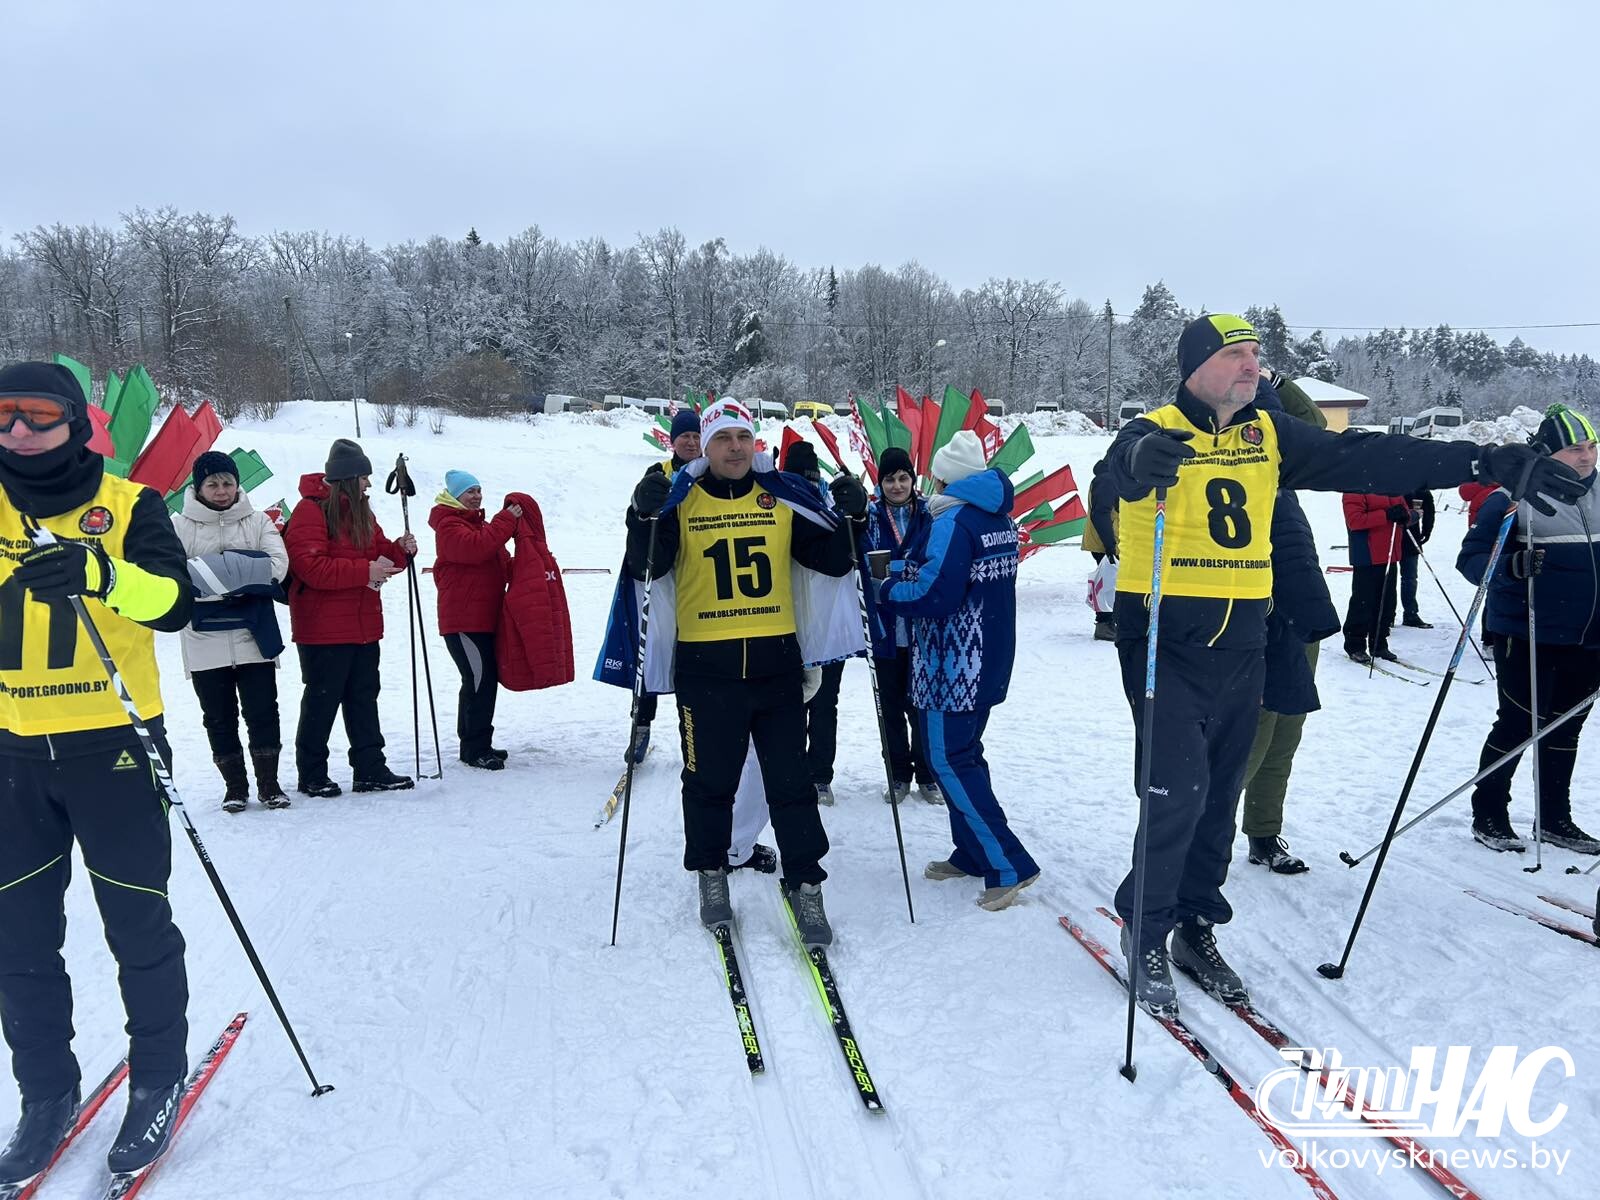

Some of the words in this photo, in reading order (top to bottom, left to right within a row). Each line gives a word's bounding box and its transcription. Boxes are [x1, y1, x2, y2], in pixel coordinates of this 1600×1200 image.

[1205, 477, 1252, 549] 8
[703, 535, 773, 600] 15
[734, 1004, 760, 1056] FISCHER
[841, 1036, 874, 1094] FISCHER
